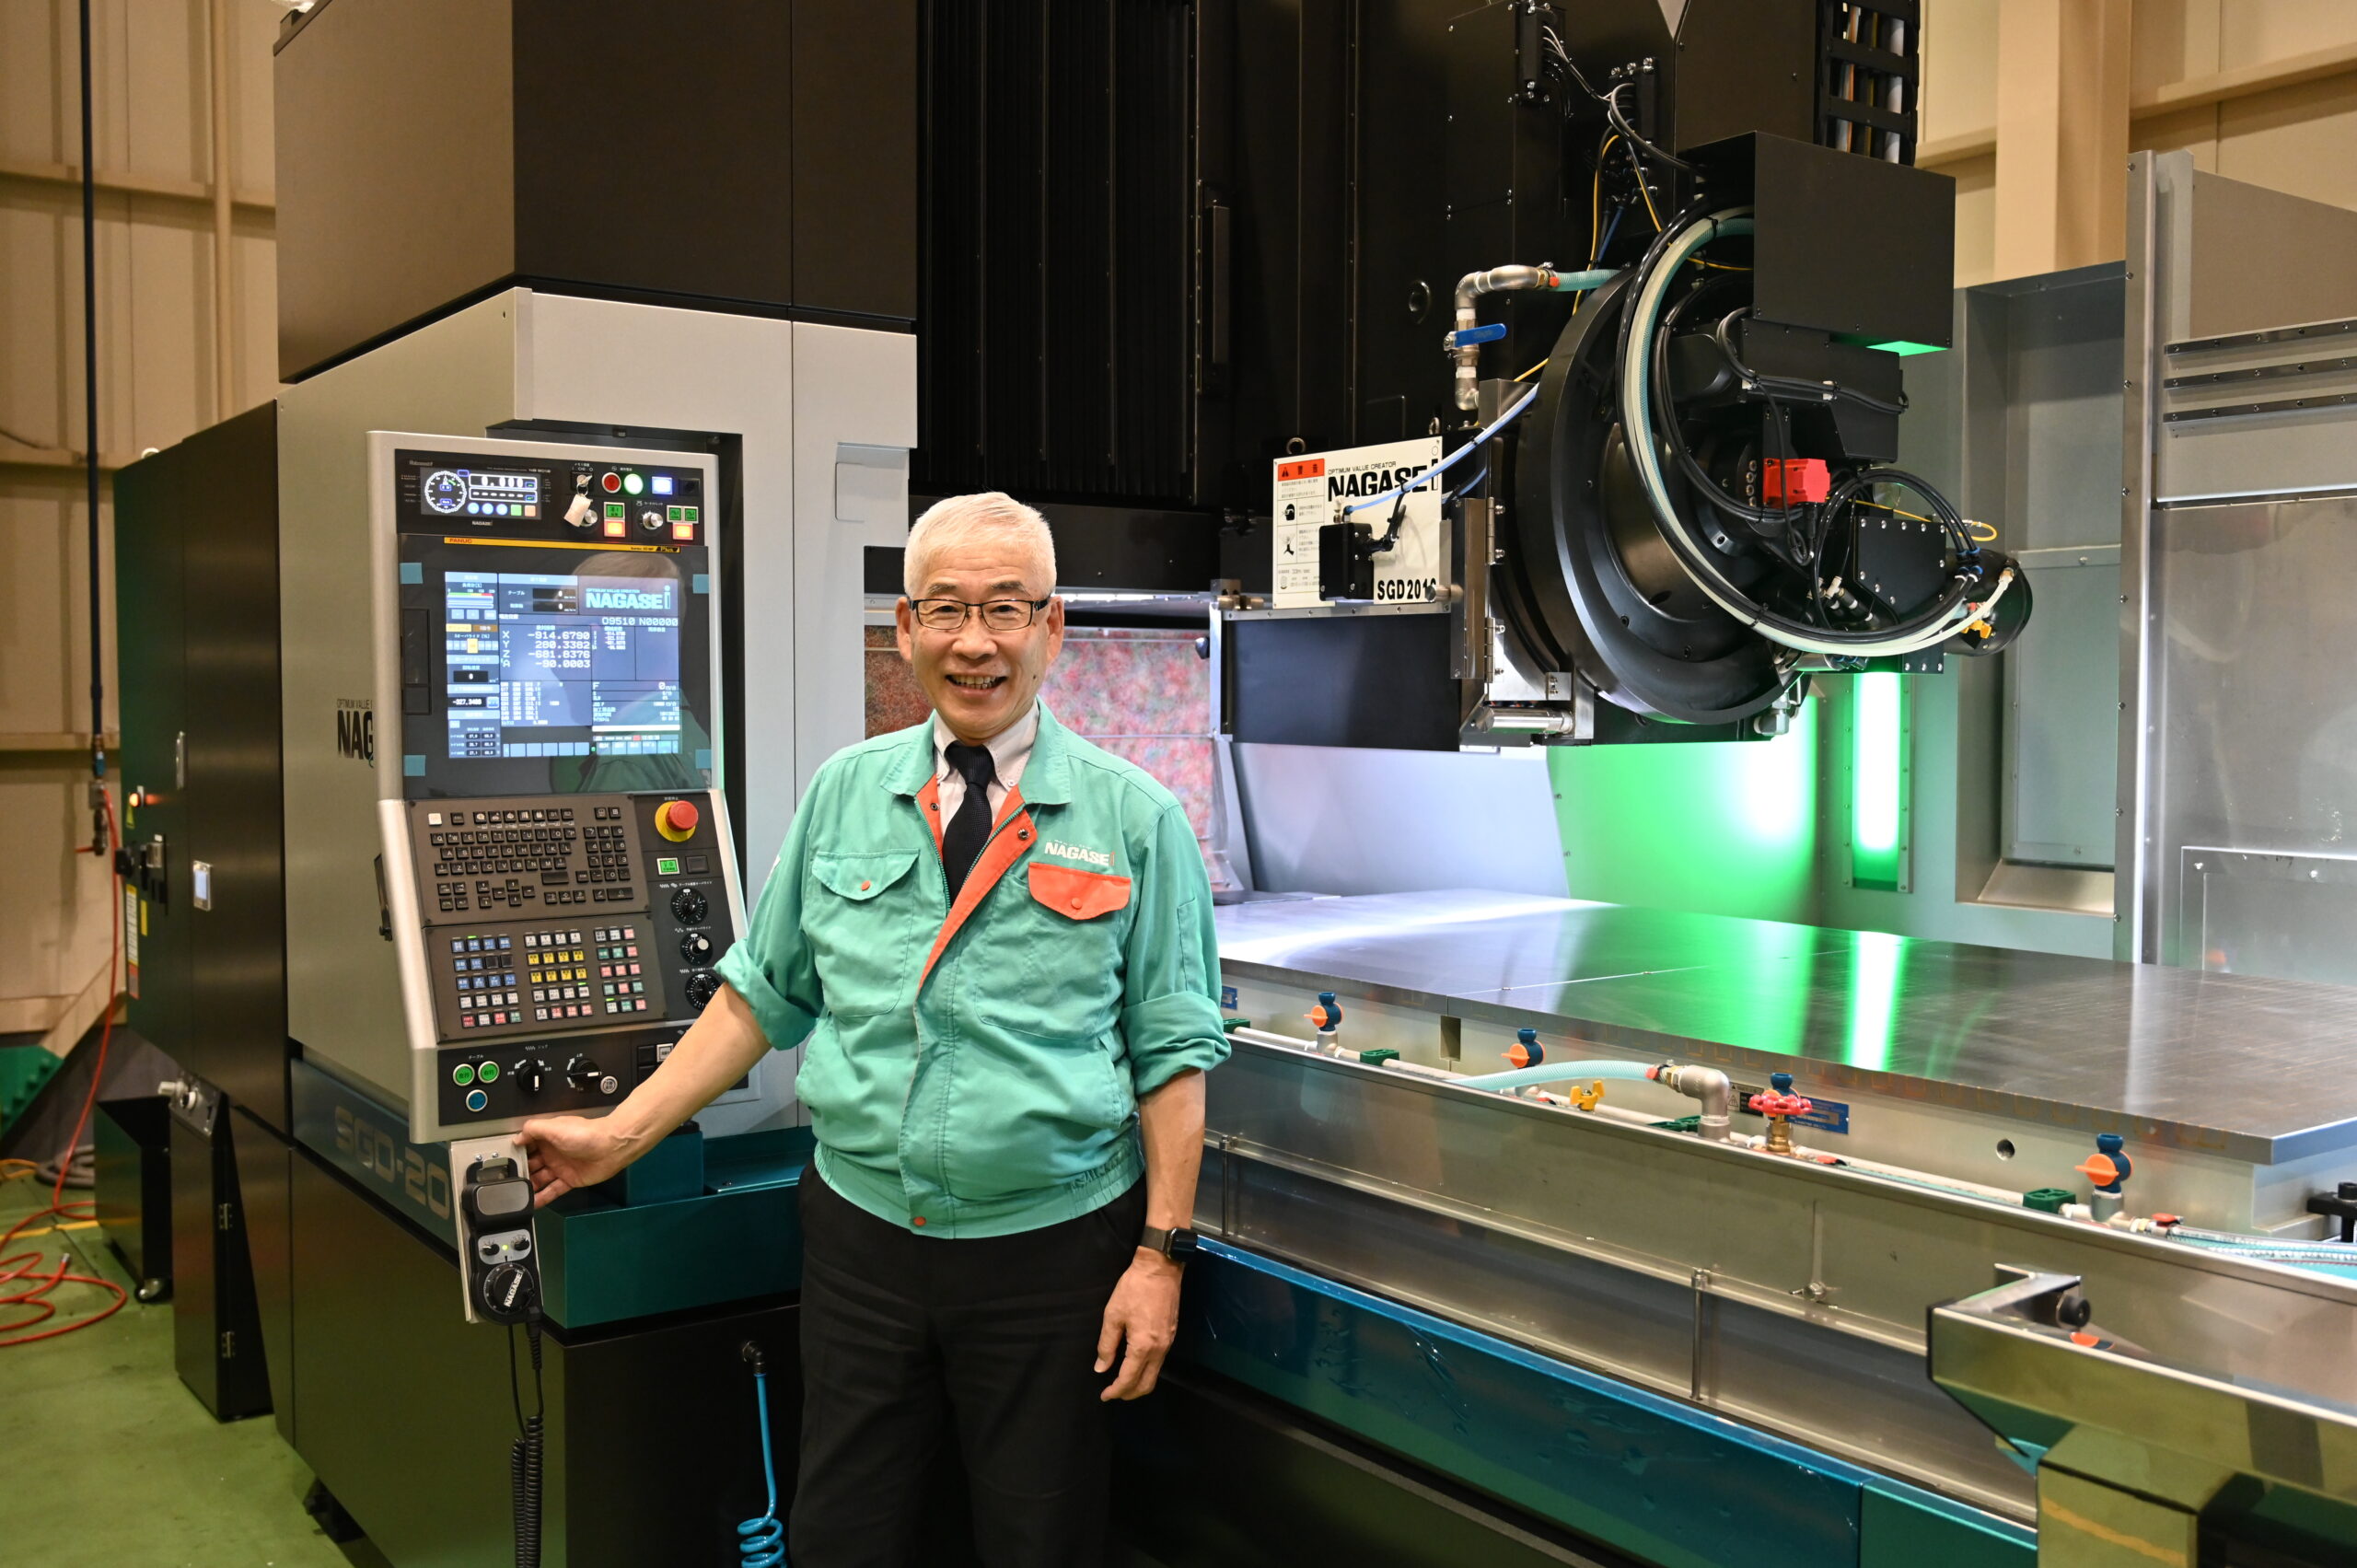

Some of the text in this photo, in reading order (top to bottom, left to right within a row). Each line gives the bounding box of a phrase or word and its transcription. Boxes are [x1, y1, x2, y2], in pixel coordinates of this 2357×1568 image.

[1371, 461, 1397, 470] CREATOR
[639, 618, 678, 626] N00000
[502, 631, 510, 639] X
[503, 660, 591, 668] A -90.0003
[335, 1106, 450, 1220] SGD-20
